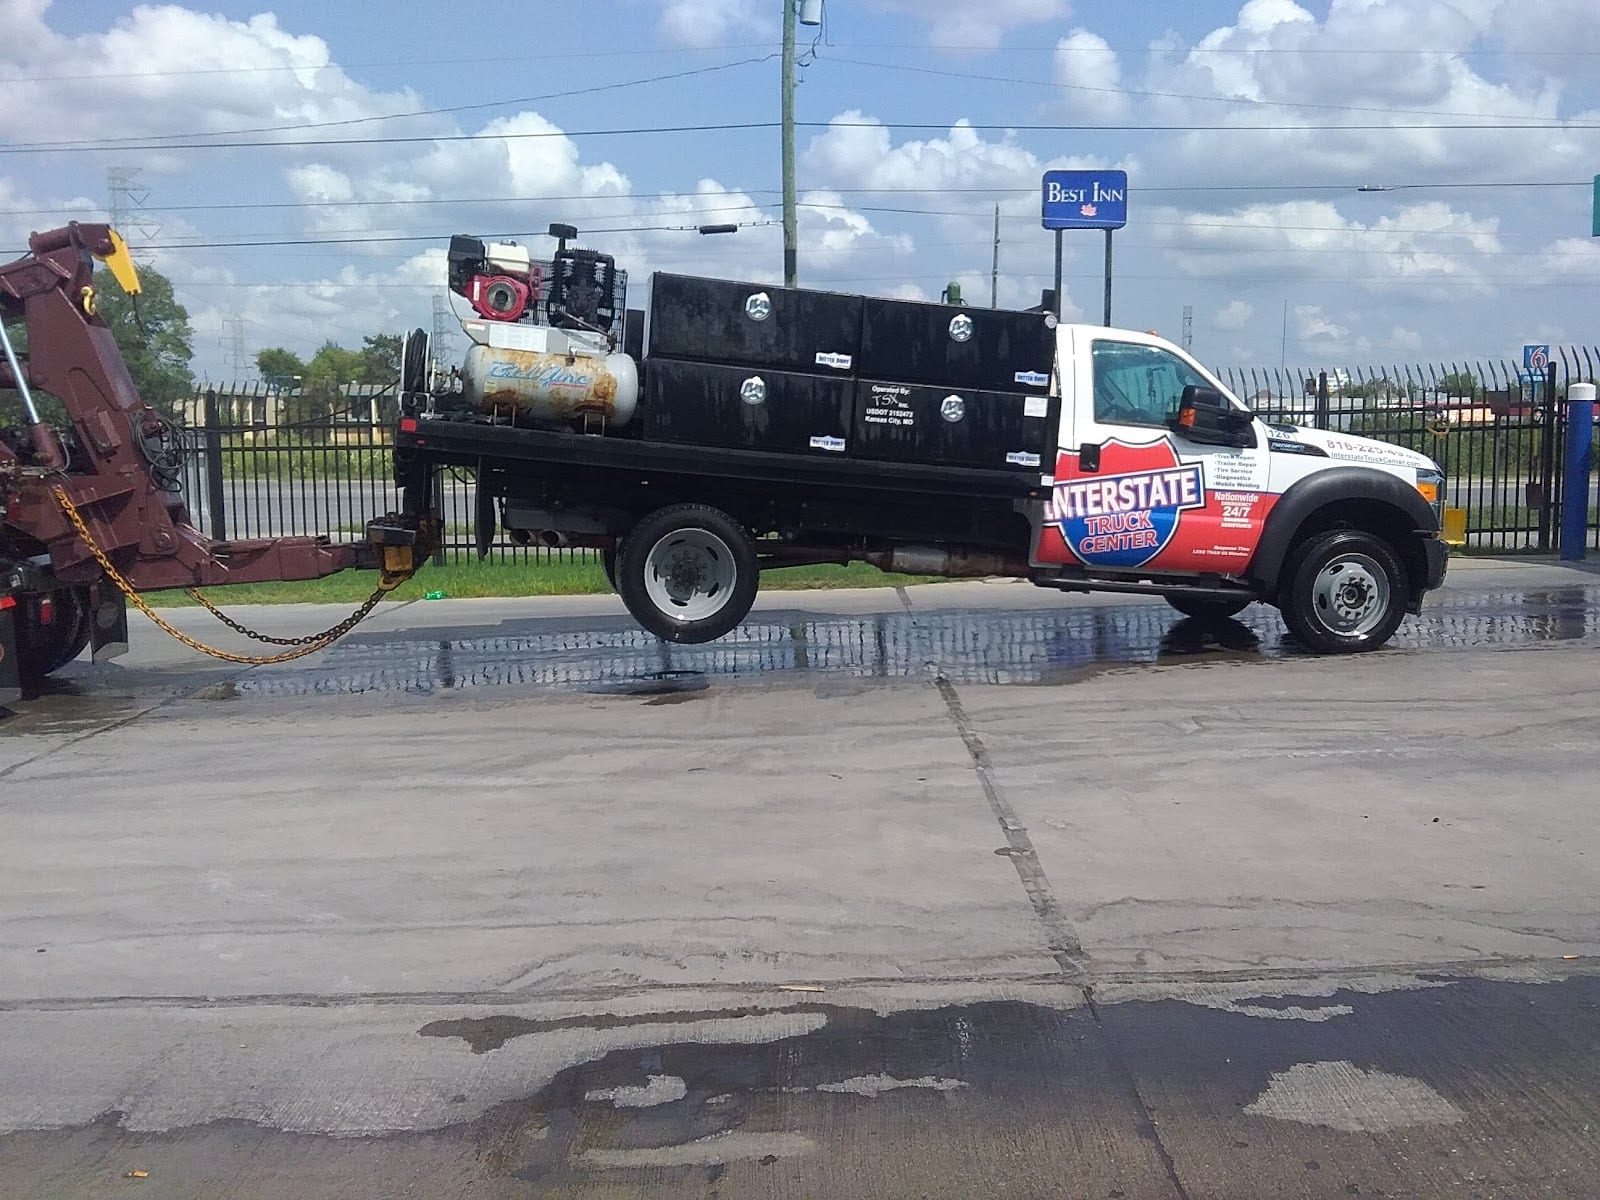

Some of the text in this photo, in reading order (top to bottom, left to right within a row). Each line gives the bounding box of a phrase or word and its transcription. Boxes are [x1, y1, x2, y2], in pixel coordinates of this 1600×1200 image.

[872, 394, 899, 406] TSX
[866, 408, 889, 416] USDOT
[1268, 429, 1290, 439] 126
[1214, 491, 1259, 502] Nationwide
[1222, 505, 1252, 517] 24/7
[1084, 509, 1154, 537] TRUCK
[1079, 530, 1160, 555] CENTER
